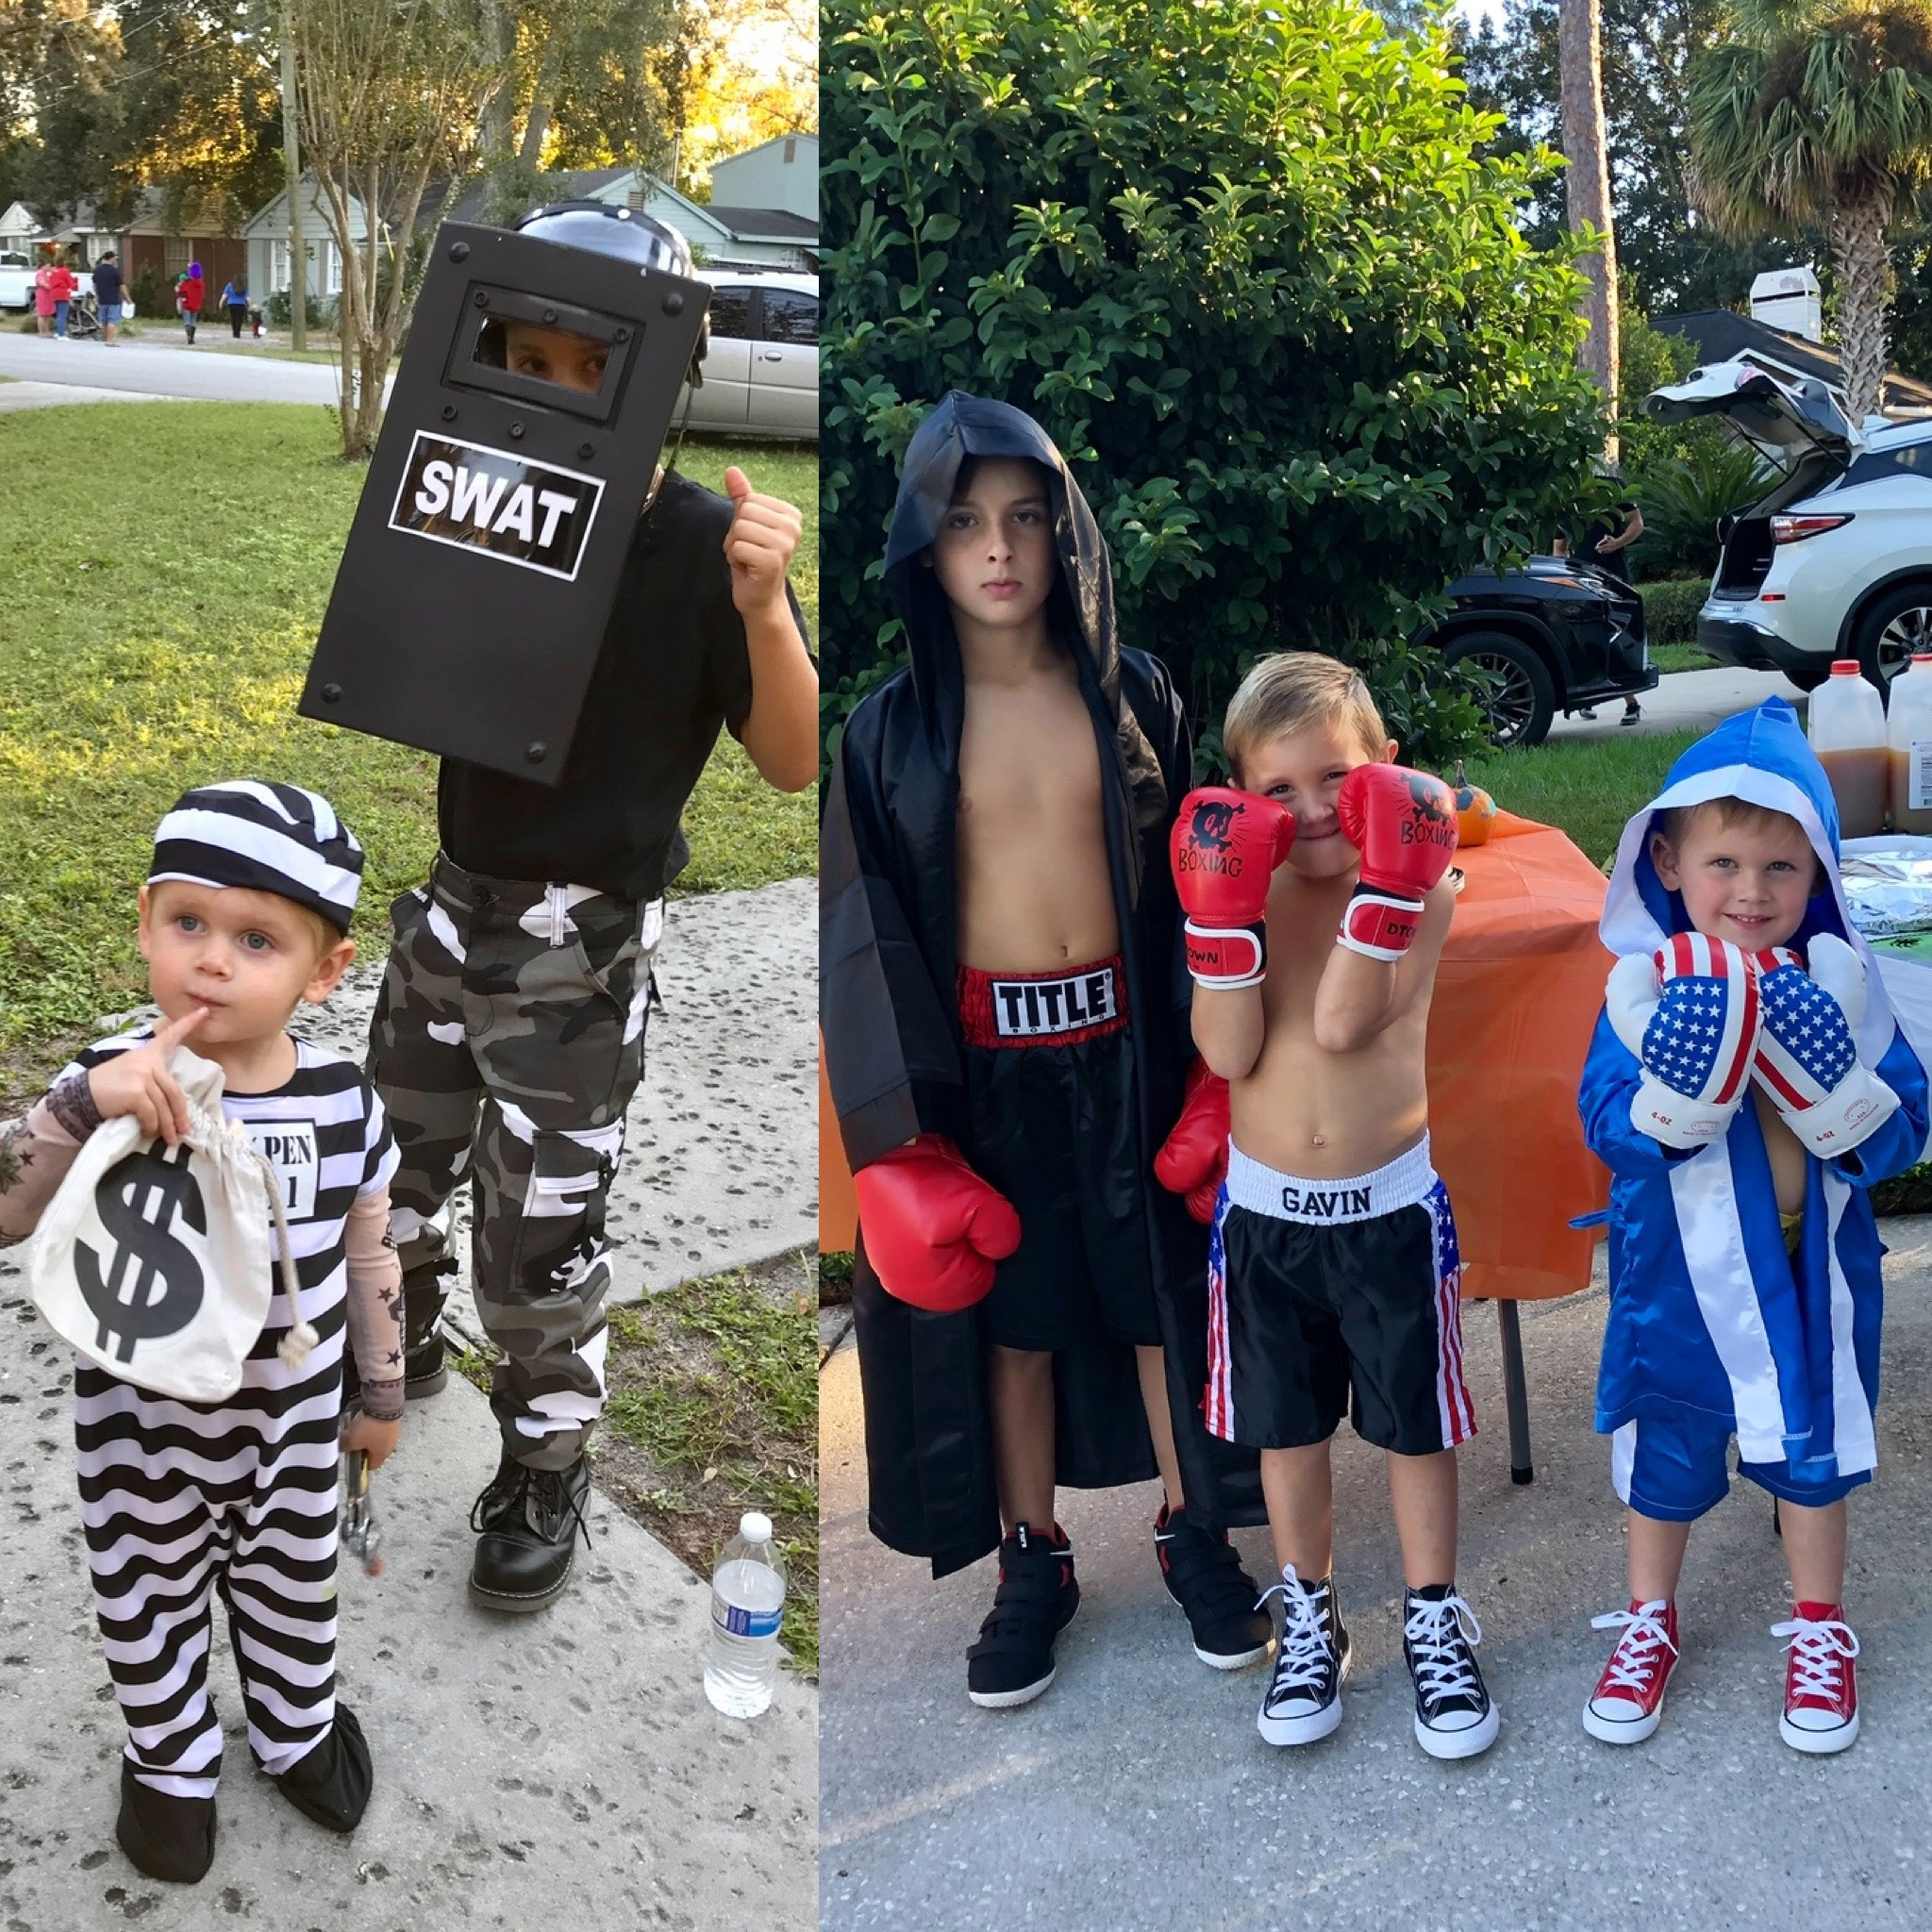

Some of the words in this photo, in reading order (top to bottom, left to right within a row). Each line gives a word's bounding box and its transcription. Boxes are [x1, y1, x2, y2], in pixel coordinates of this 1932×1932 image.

[415, 459, 578, 548] SWAT
[1178, 848, 1243, 878] BOXING
[998, 974, 1108, 1028] TITLE
[1012, 1013, 1106, 1035] BOXING
[264, 1135, 312, 1165] PEN
[1282, 1185, 1372, 1218] GAVIN
